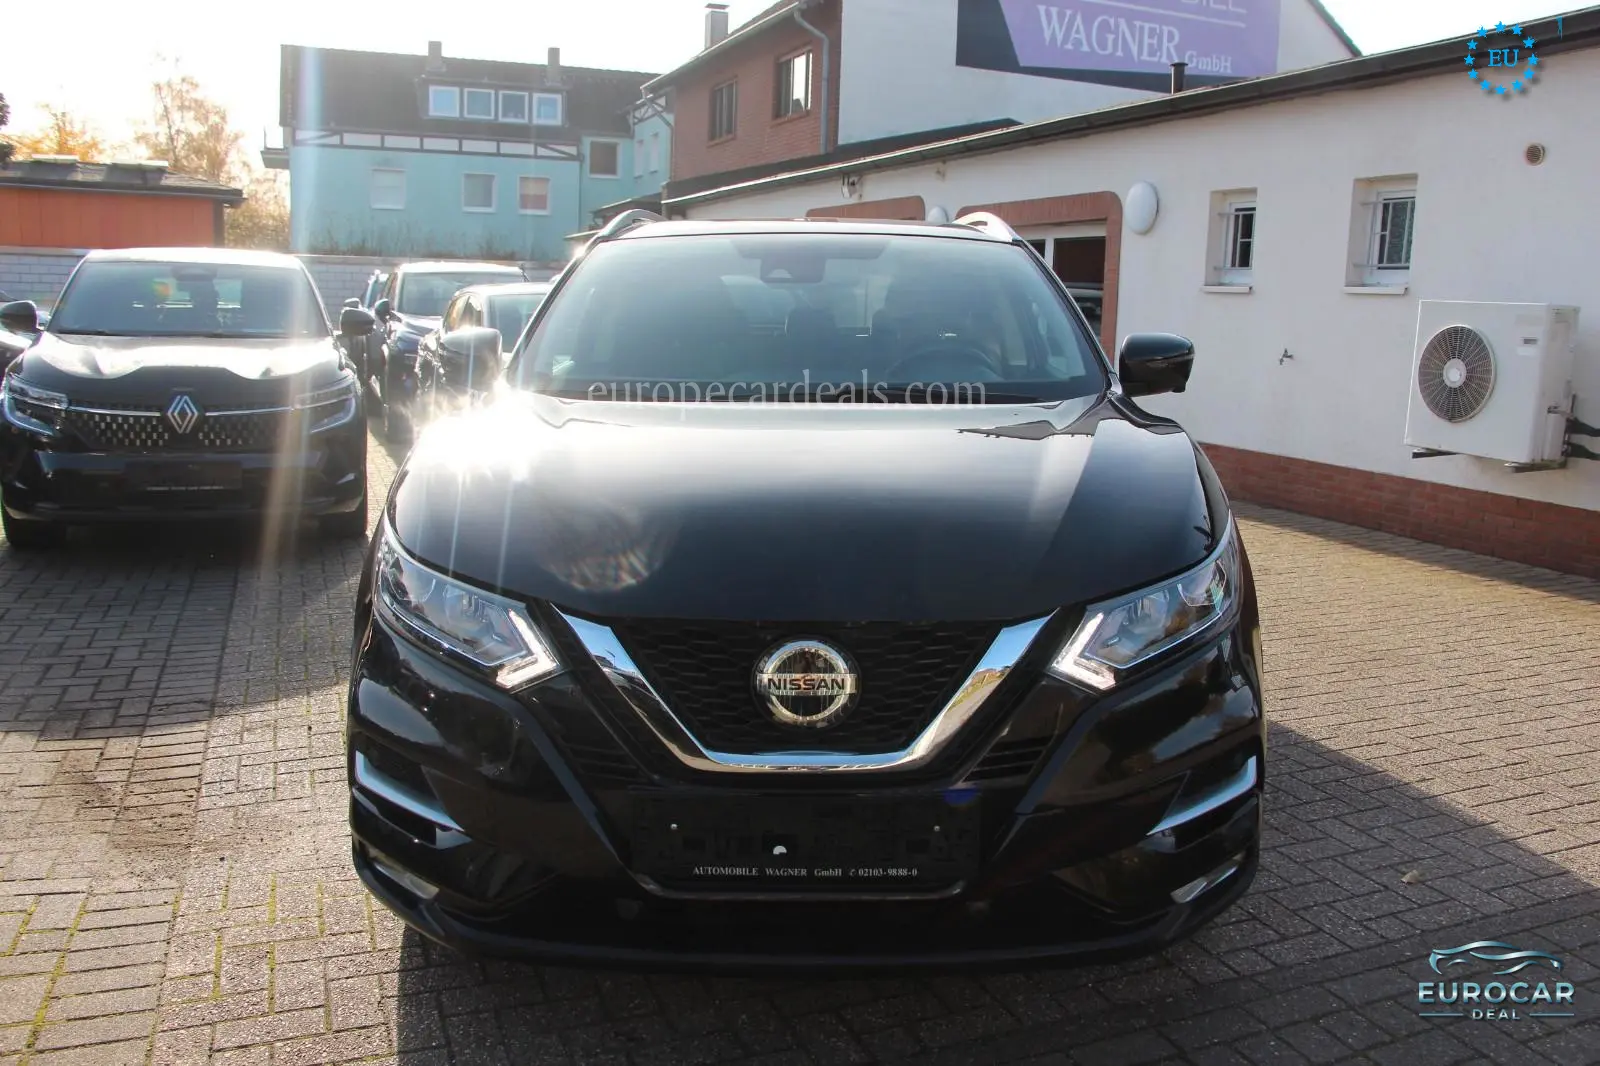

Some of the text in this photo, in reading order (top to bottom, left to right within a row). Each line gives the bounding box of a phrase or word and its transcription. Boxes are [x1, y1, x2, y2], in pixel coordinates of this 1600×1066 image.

[1037, 5, 1232, 73] WAGNER GmbH
[767, 678, 845, 691] NISSAN
[693, 866, 759, 876] AUTOMOBILE
[765, 867, 807, 877] WAGNER
[814, 868, 842, 877] GmbH
